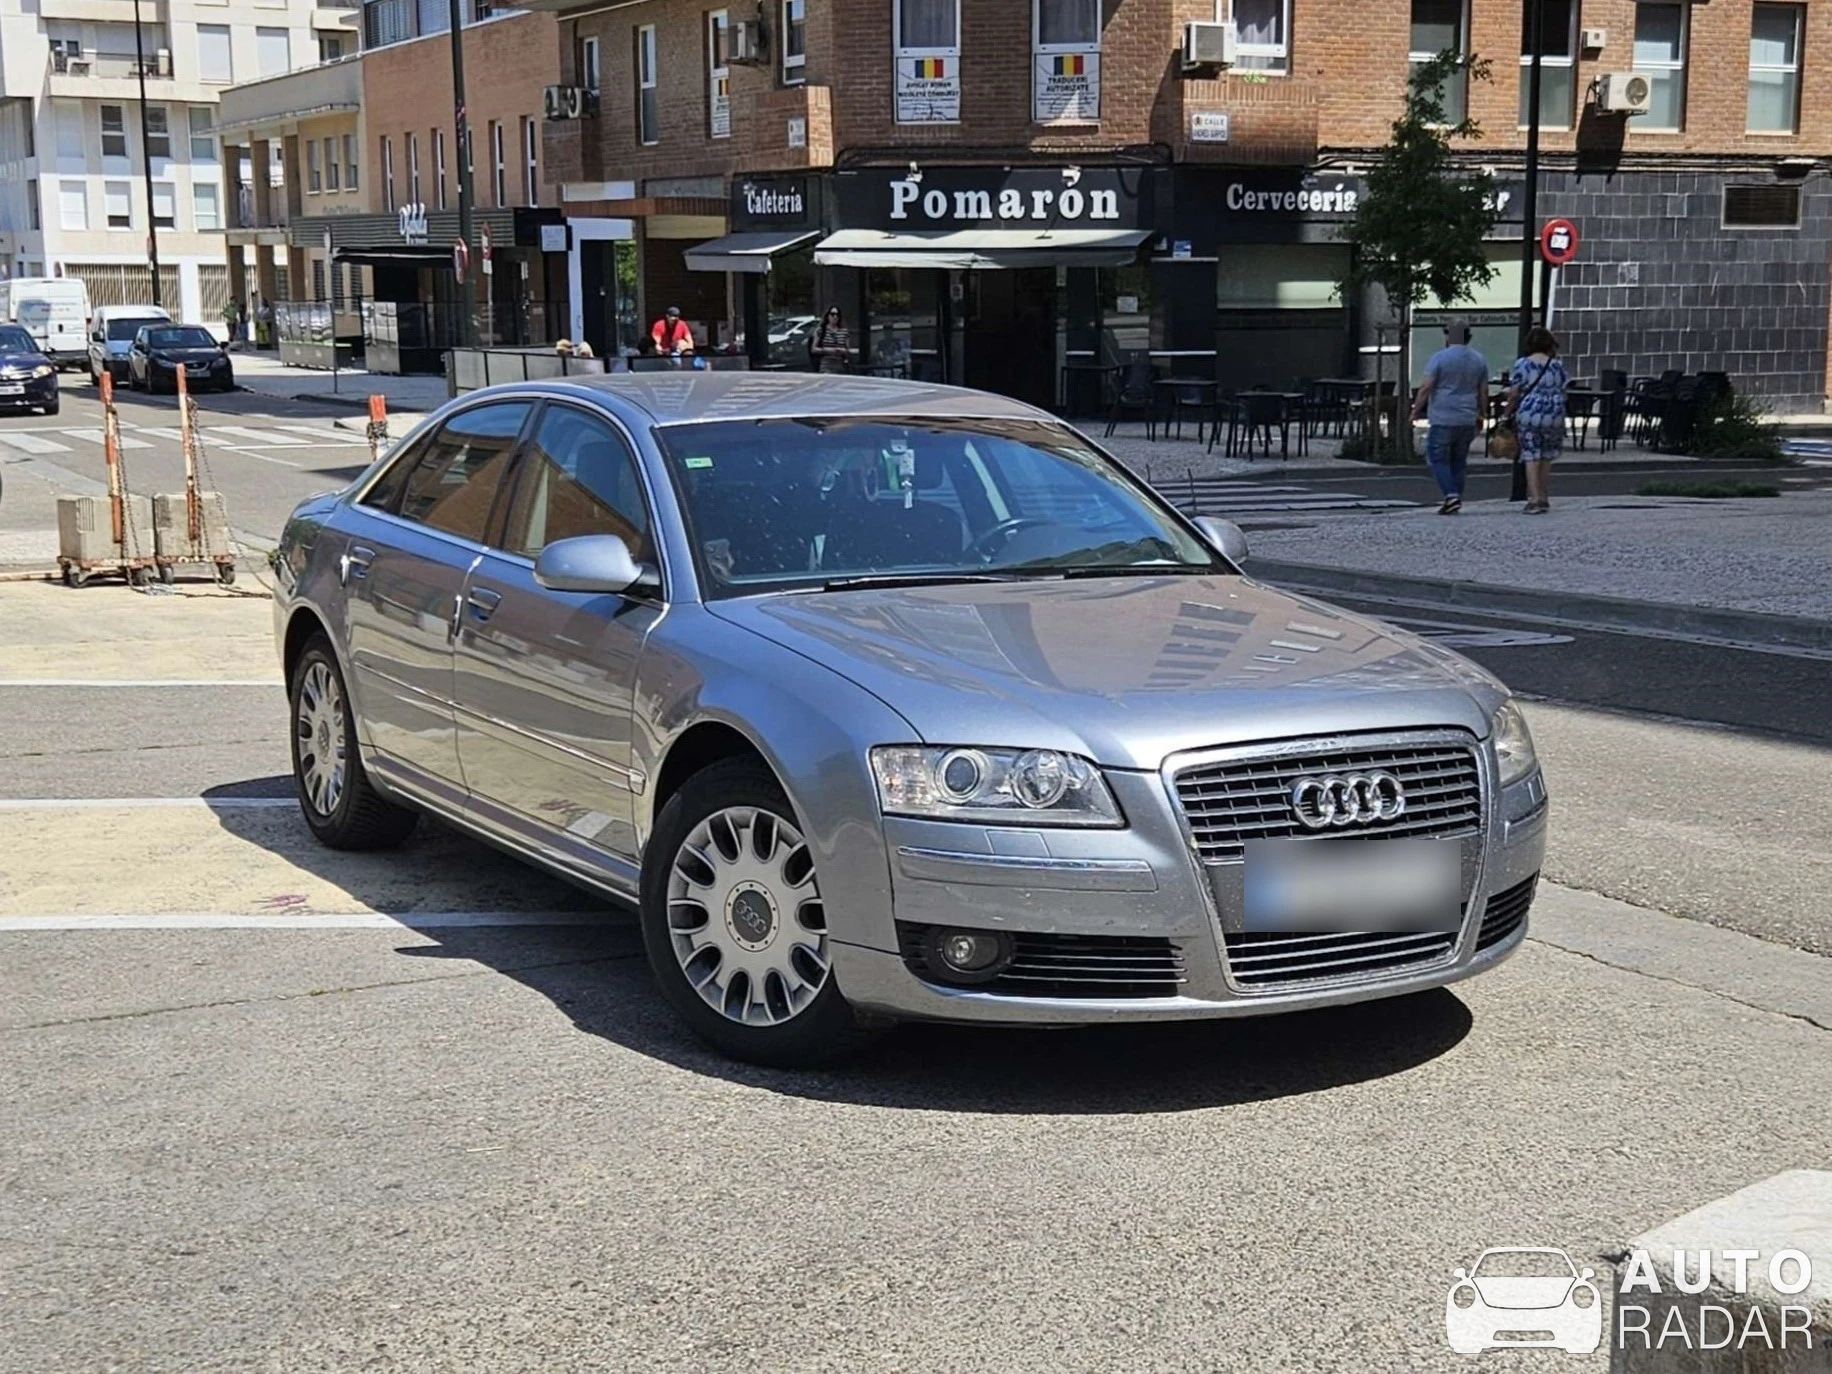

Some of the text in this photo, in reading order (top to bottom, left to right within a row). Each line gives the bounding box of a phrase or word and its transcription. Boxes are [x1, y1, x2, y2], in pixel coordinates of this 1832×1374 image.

[1204, 118, 1224, 126] CALLE
[747, 186, 802, 214] Cafetería
[889, 180, 1120, 219] Pomarón
[1226, 183, 1359, 212] Cervecería
